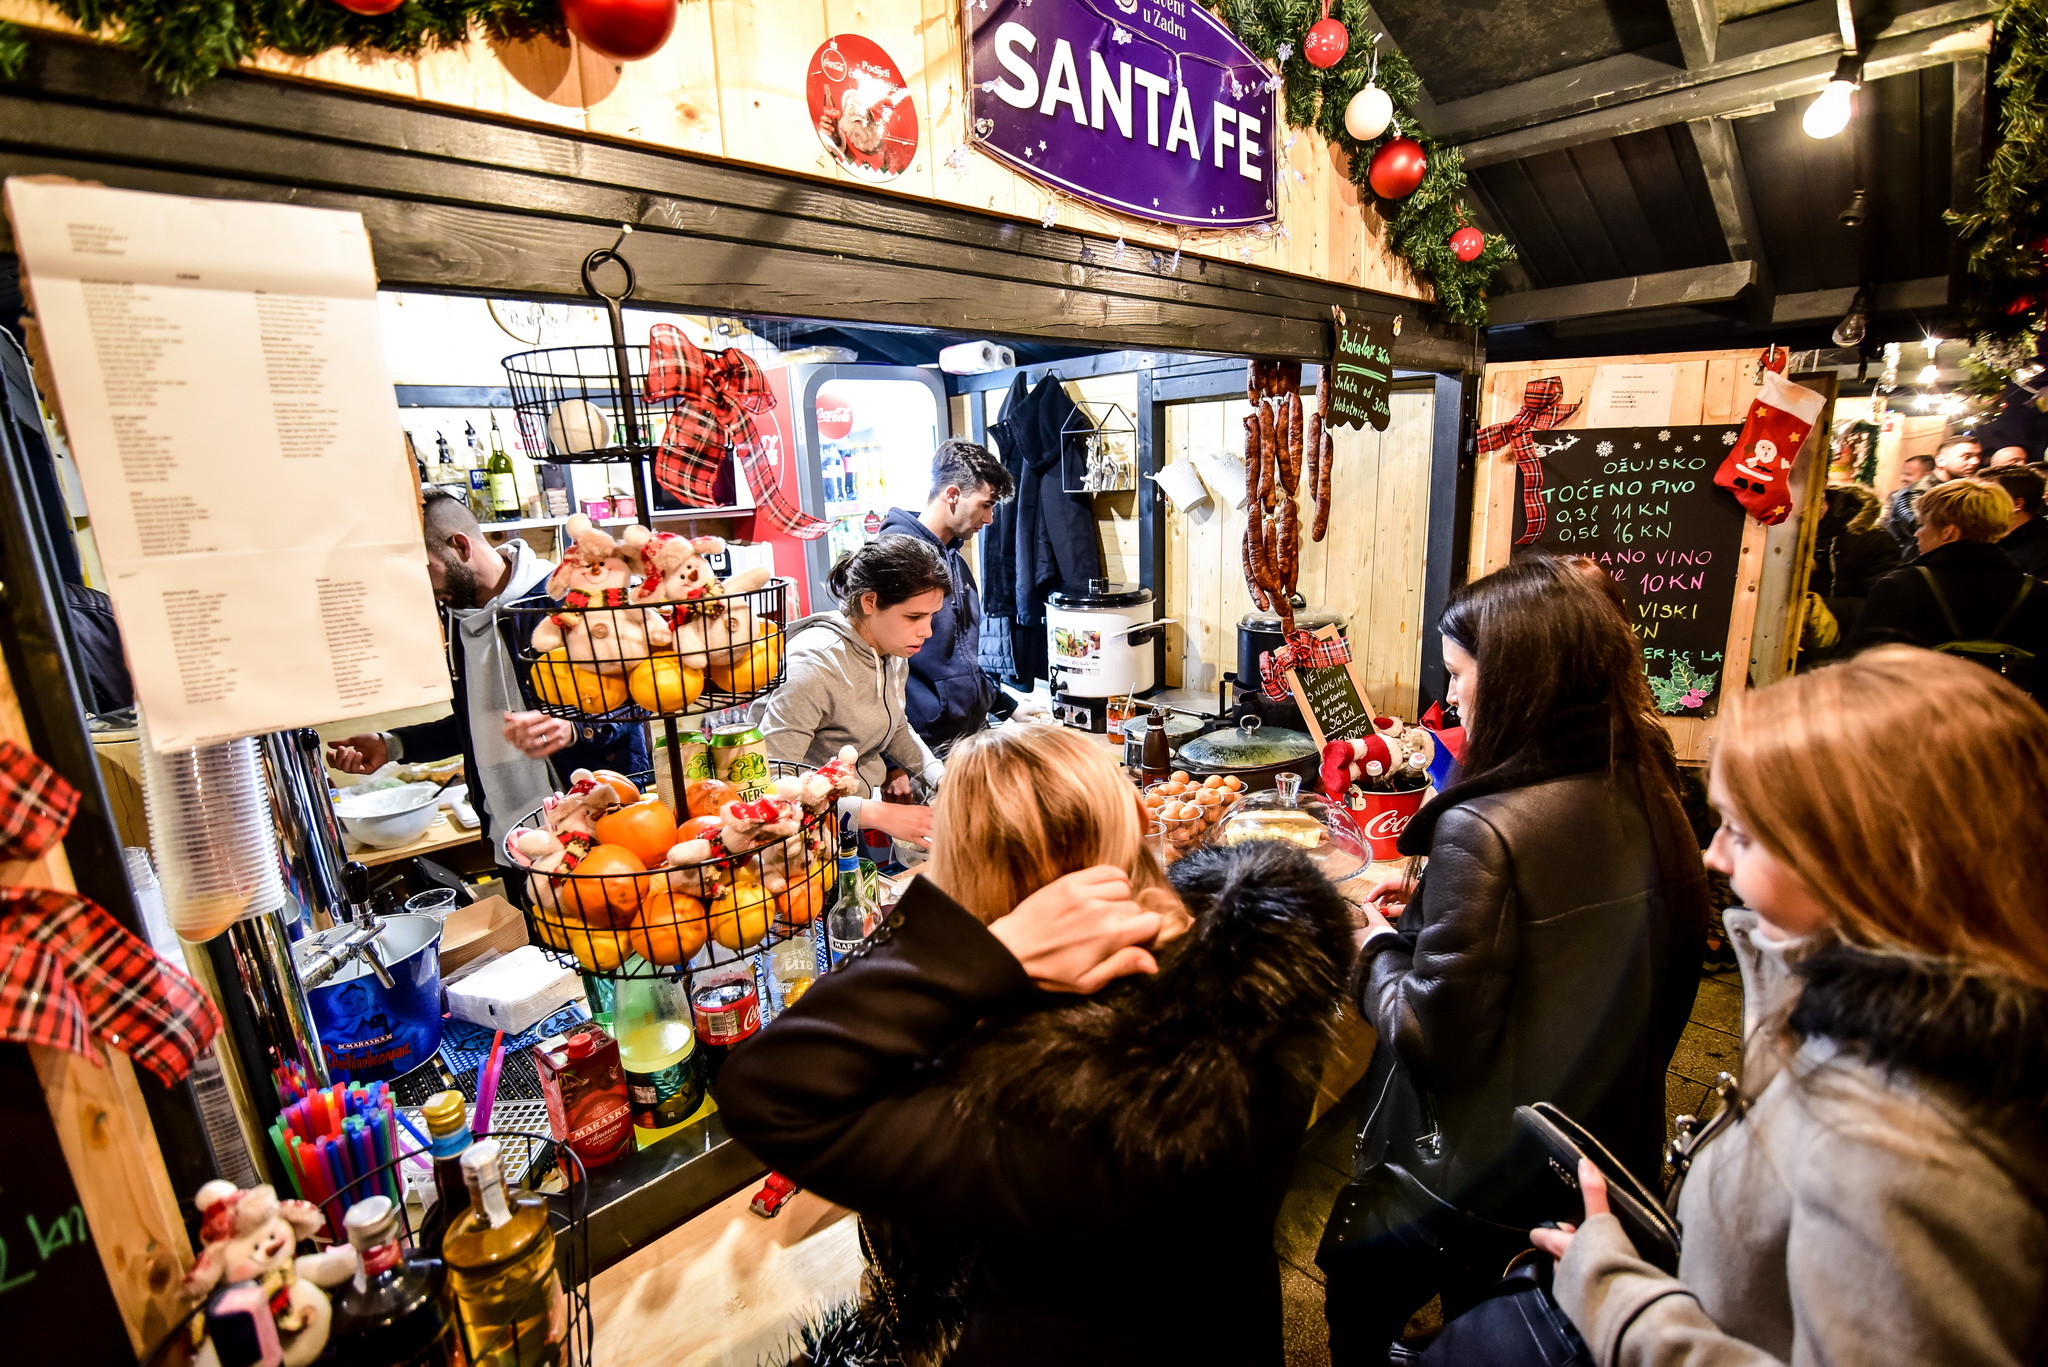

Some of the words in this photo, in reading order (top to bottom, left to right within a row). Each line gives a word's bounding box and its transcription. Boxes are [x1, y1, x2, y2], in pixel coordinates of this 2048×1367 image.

[1143, 8, 1151, 23] u
[1153, 9, 1187, 41] Zadru
[861, 60, 890, 79] Podijeli
[993, 21, 1201, 161] SANTA
[1213, 100, 1262, 182] FE
[1363, 385, 1374, 399] od
[1603, 457, 1706, 475] OŽUJSKO
[1540, 478, 1644, 504] TOČENO
[1651, 479, 1696, 495] PIVO
[1611, 503, 1632, 520] 11
[1638, 500, 1669, 517] KN
[1612, 522, 1634, 543] 16
[1640, 521, 1672, 538] KN
[1656, 549, 1713, 567] VINO
[1640, 572, 1664, 595] 10
[1668, 571, 1705, 590] KN
[1638, 601, 1698, 620] VISKI
[1630, 621, 1659, 640] KN
[1341, 705, 1356, 721] KN
[574, 1105, 630, 1140] MARASKA
